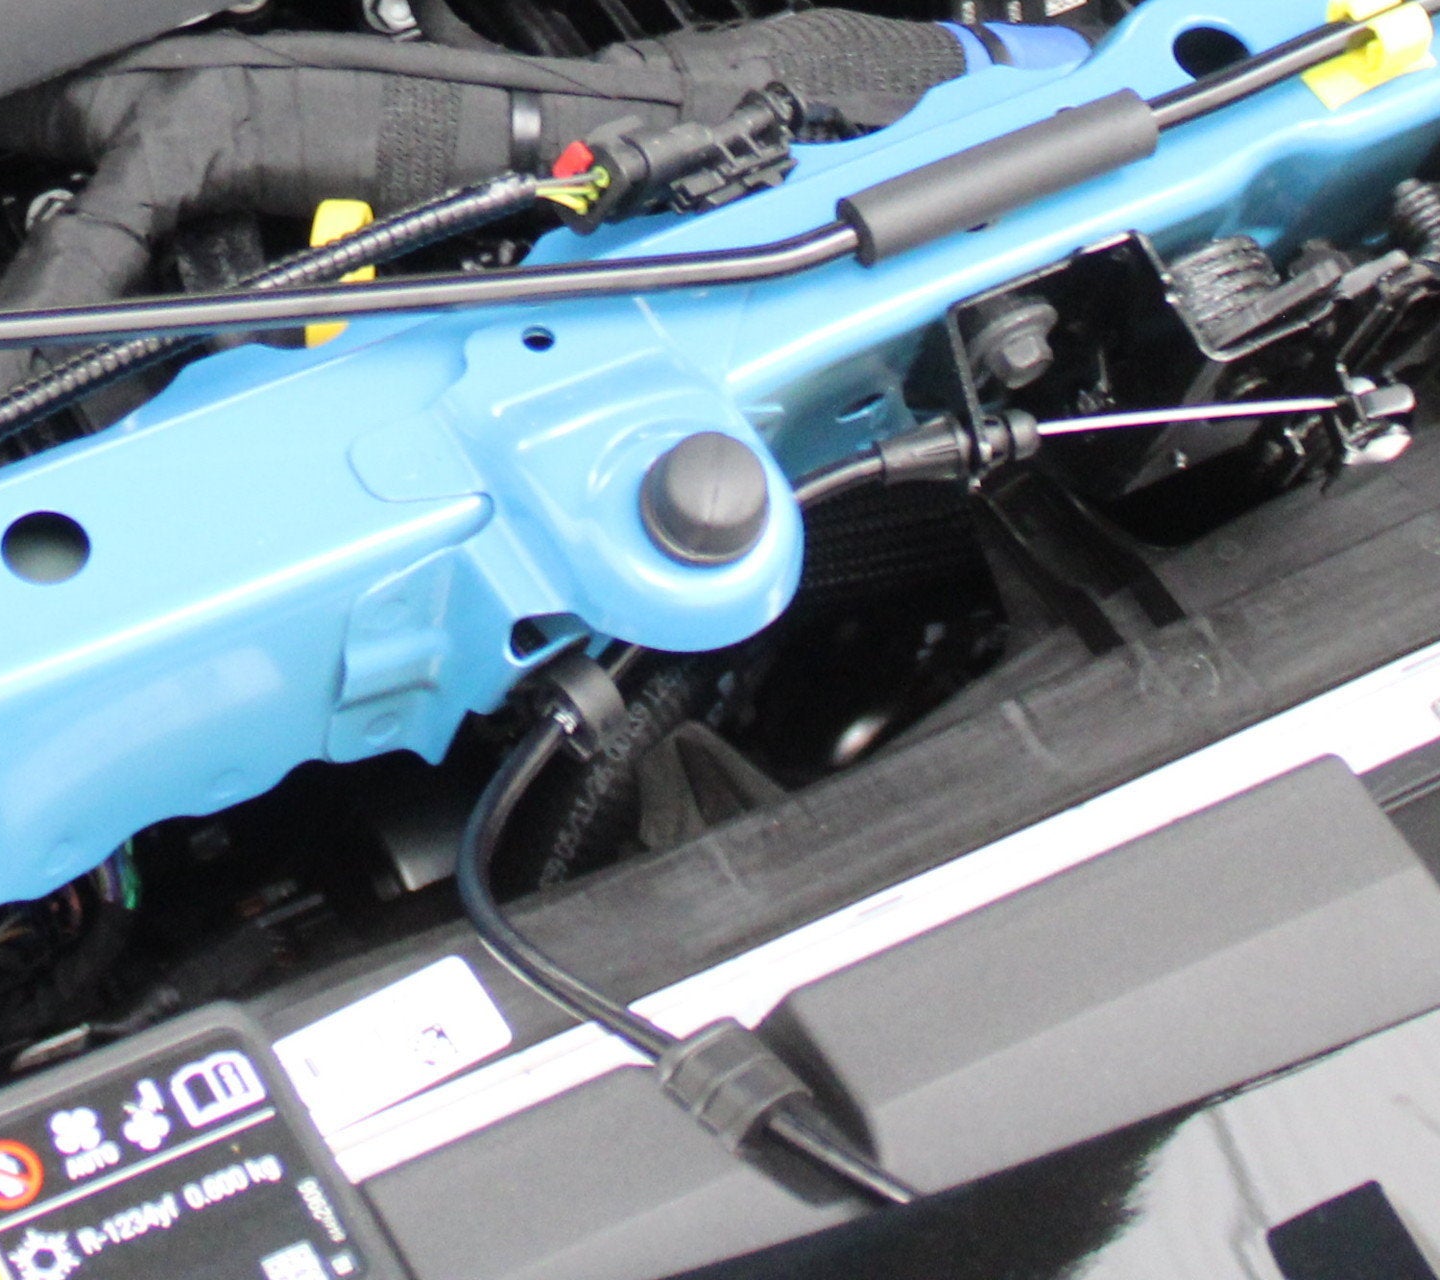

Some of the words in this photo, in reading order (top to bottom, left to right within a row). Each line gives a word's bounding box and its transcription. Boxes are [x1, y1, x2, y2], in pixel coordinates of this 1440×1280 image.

[65, 1141, 121, 1181] AUTO
[77, 1191, 180, 1256] R-1234yf
[248, 1154, 284, 1190] kg
